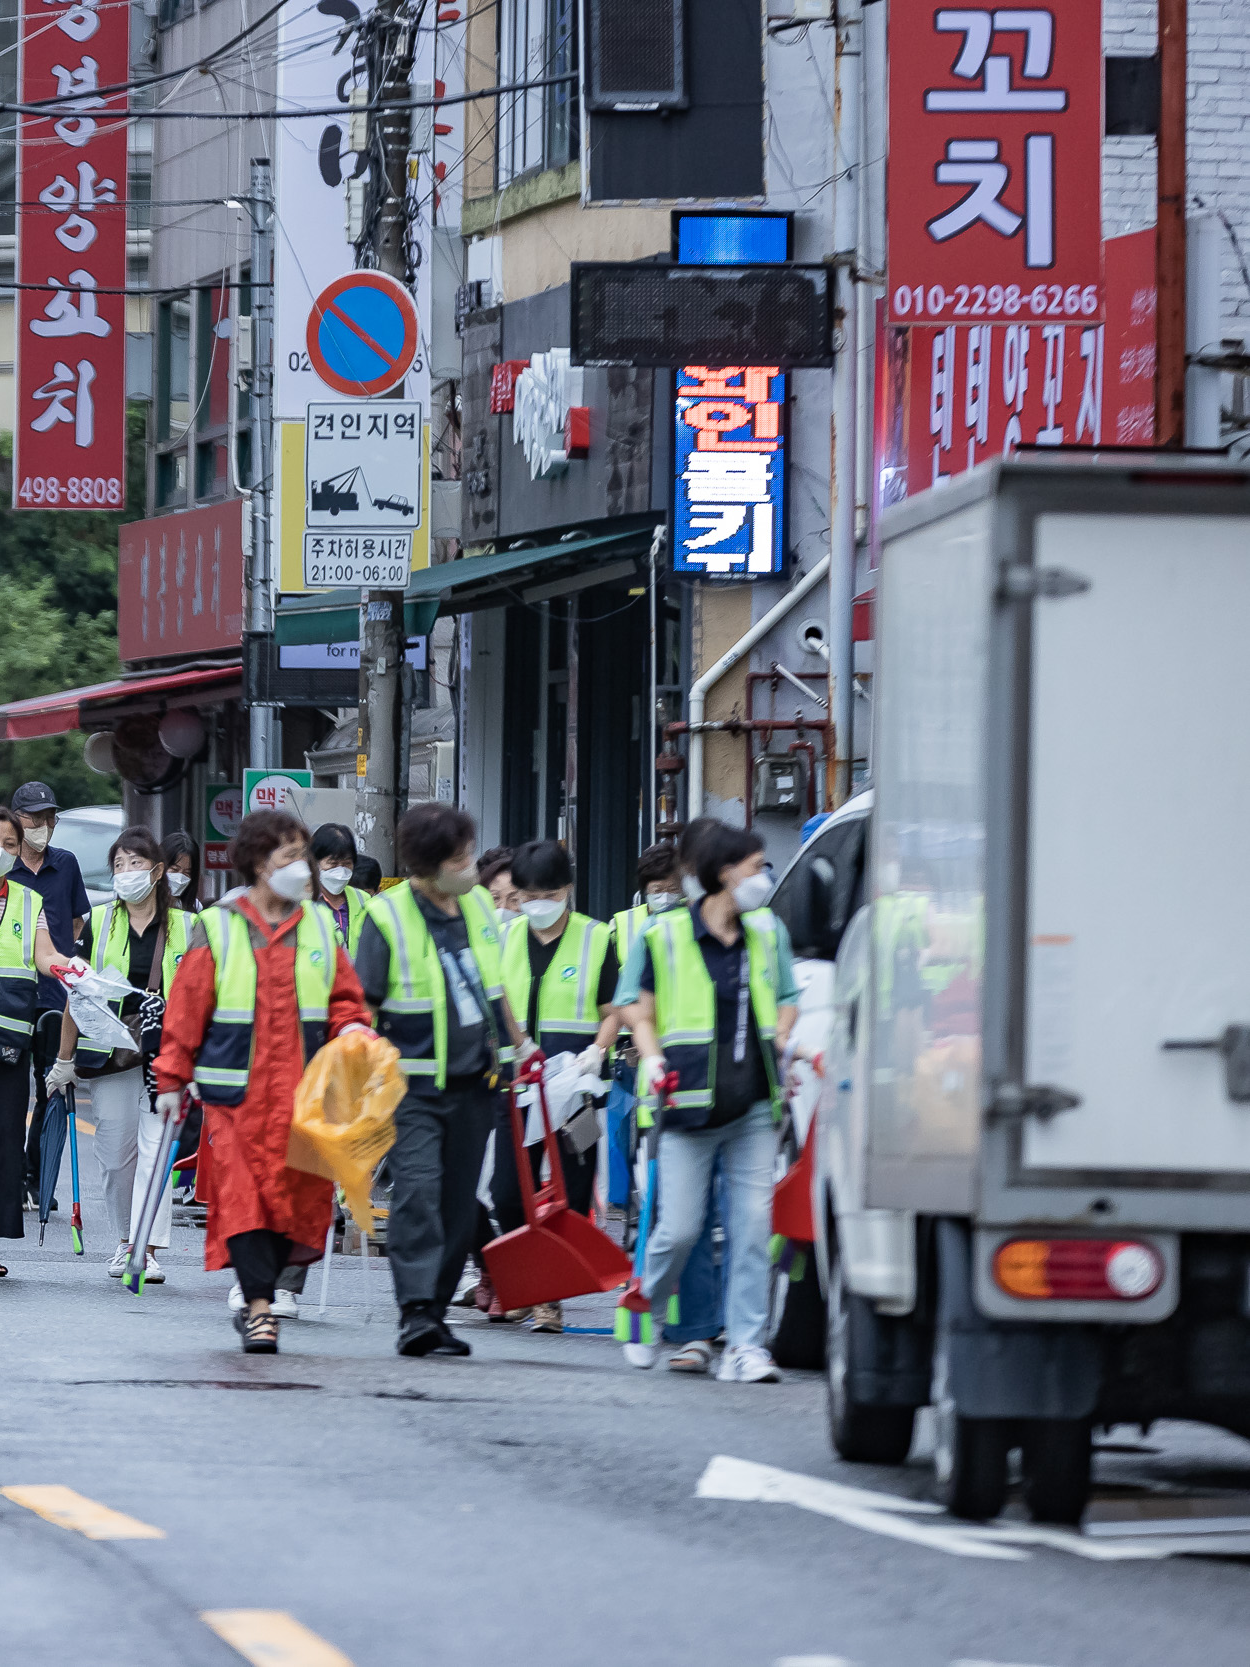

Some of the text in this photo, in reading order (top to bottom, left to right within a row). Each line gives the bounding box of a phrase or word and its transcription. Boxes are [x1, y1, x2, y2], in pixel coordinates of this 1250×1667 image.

[893, 284, 1098, 316] 010-2298-6266
[314, 412, 415, 440] 견인지역
[19, 476, 122, 504] 498-8808
[311, 537, 407, 559] 주차허용시간
[311, 564, 403, 581] 21:00-06:00
